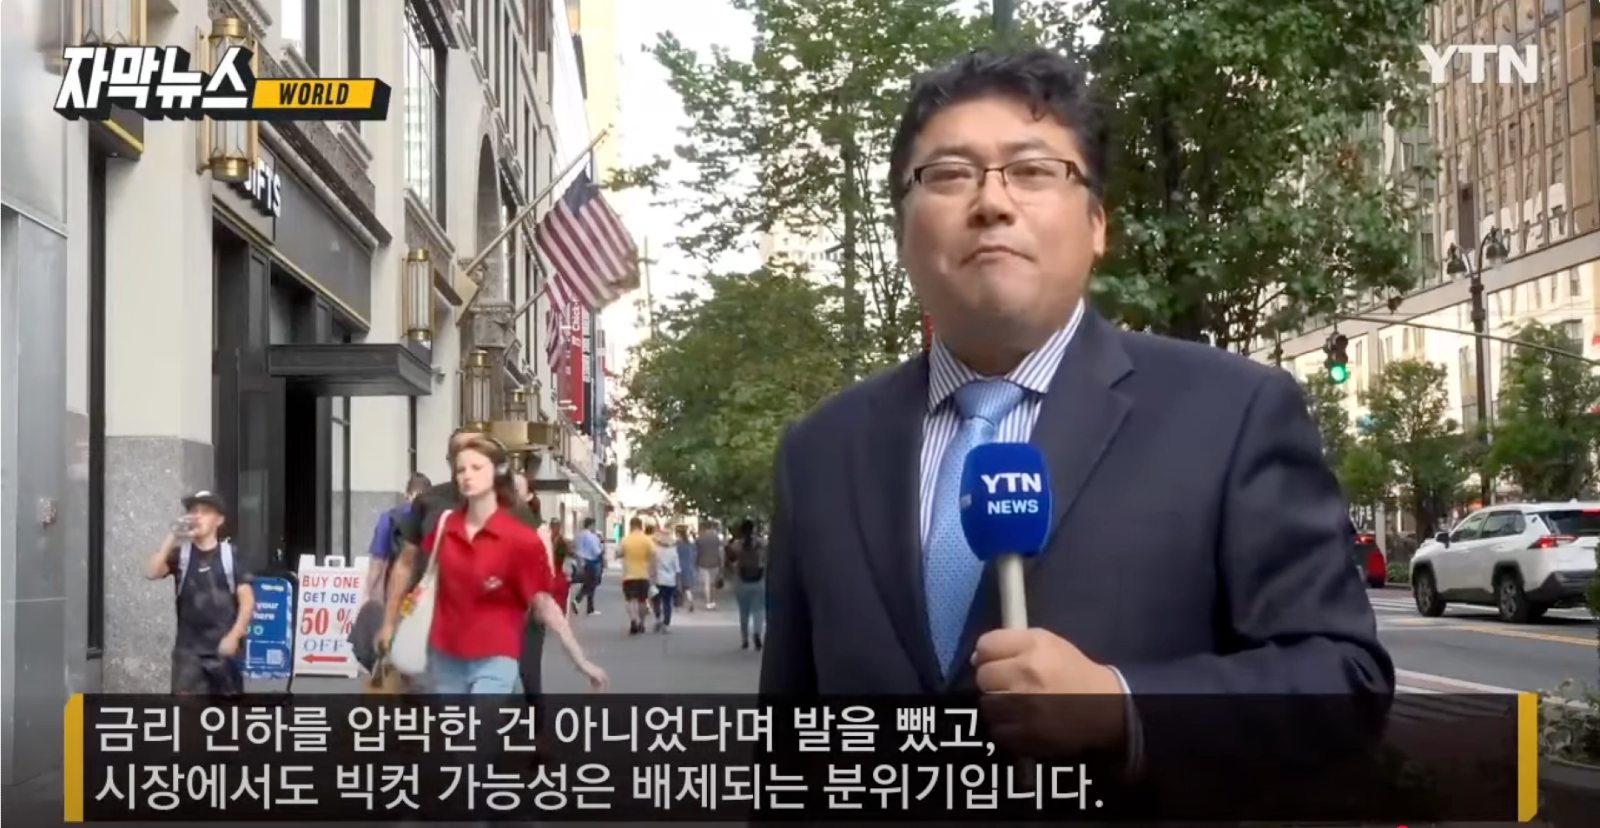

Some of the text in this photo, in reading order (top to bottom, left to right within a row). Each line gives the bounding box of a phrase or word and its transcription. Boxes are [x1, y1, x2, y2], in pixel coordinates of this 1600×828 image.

[981, 472, 1042, 494] YTN
[987, 499, 1039, 515] NEWS
[302, 575, 360, 588] BUY ONE
[303, 592, 356, 604] GET ONE
[303, 640, 345, 652] OFF
